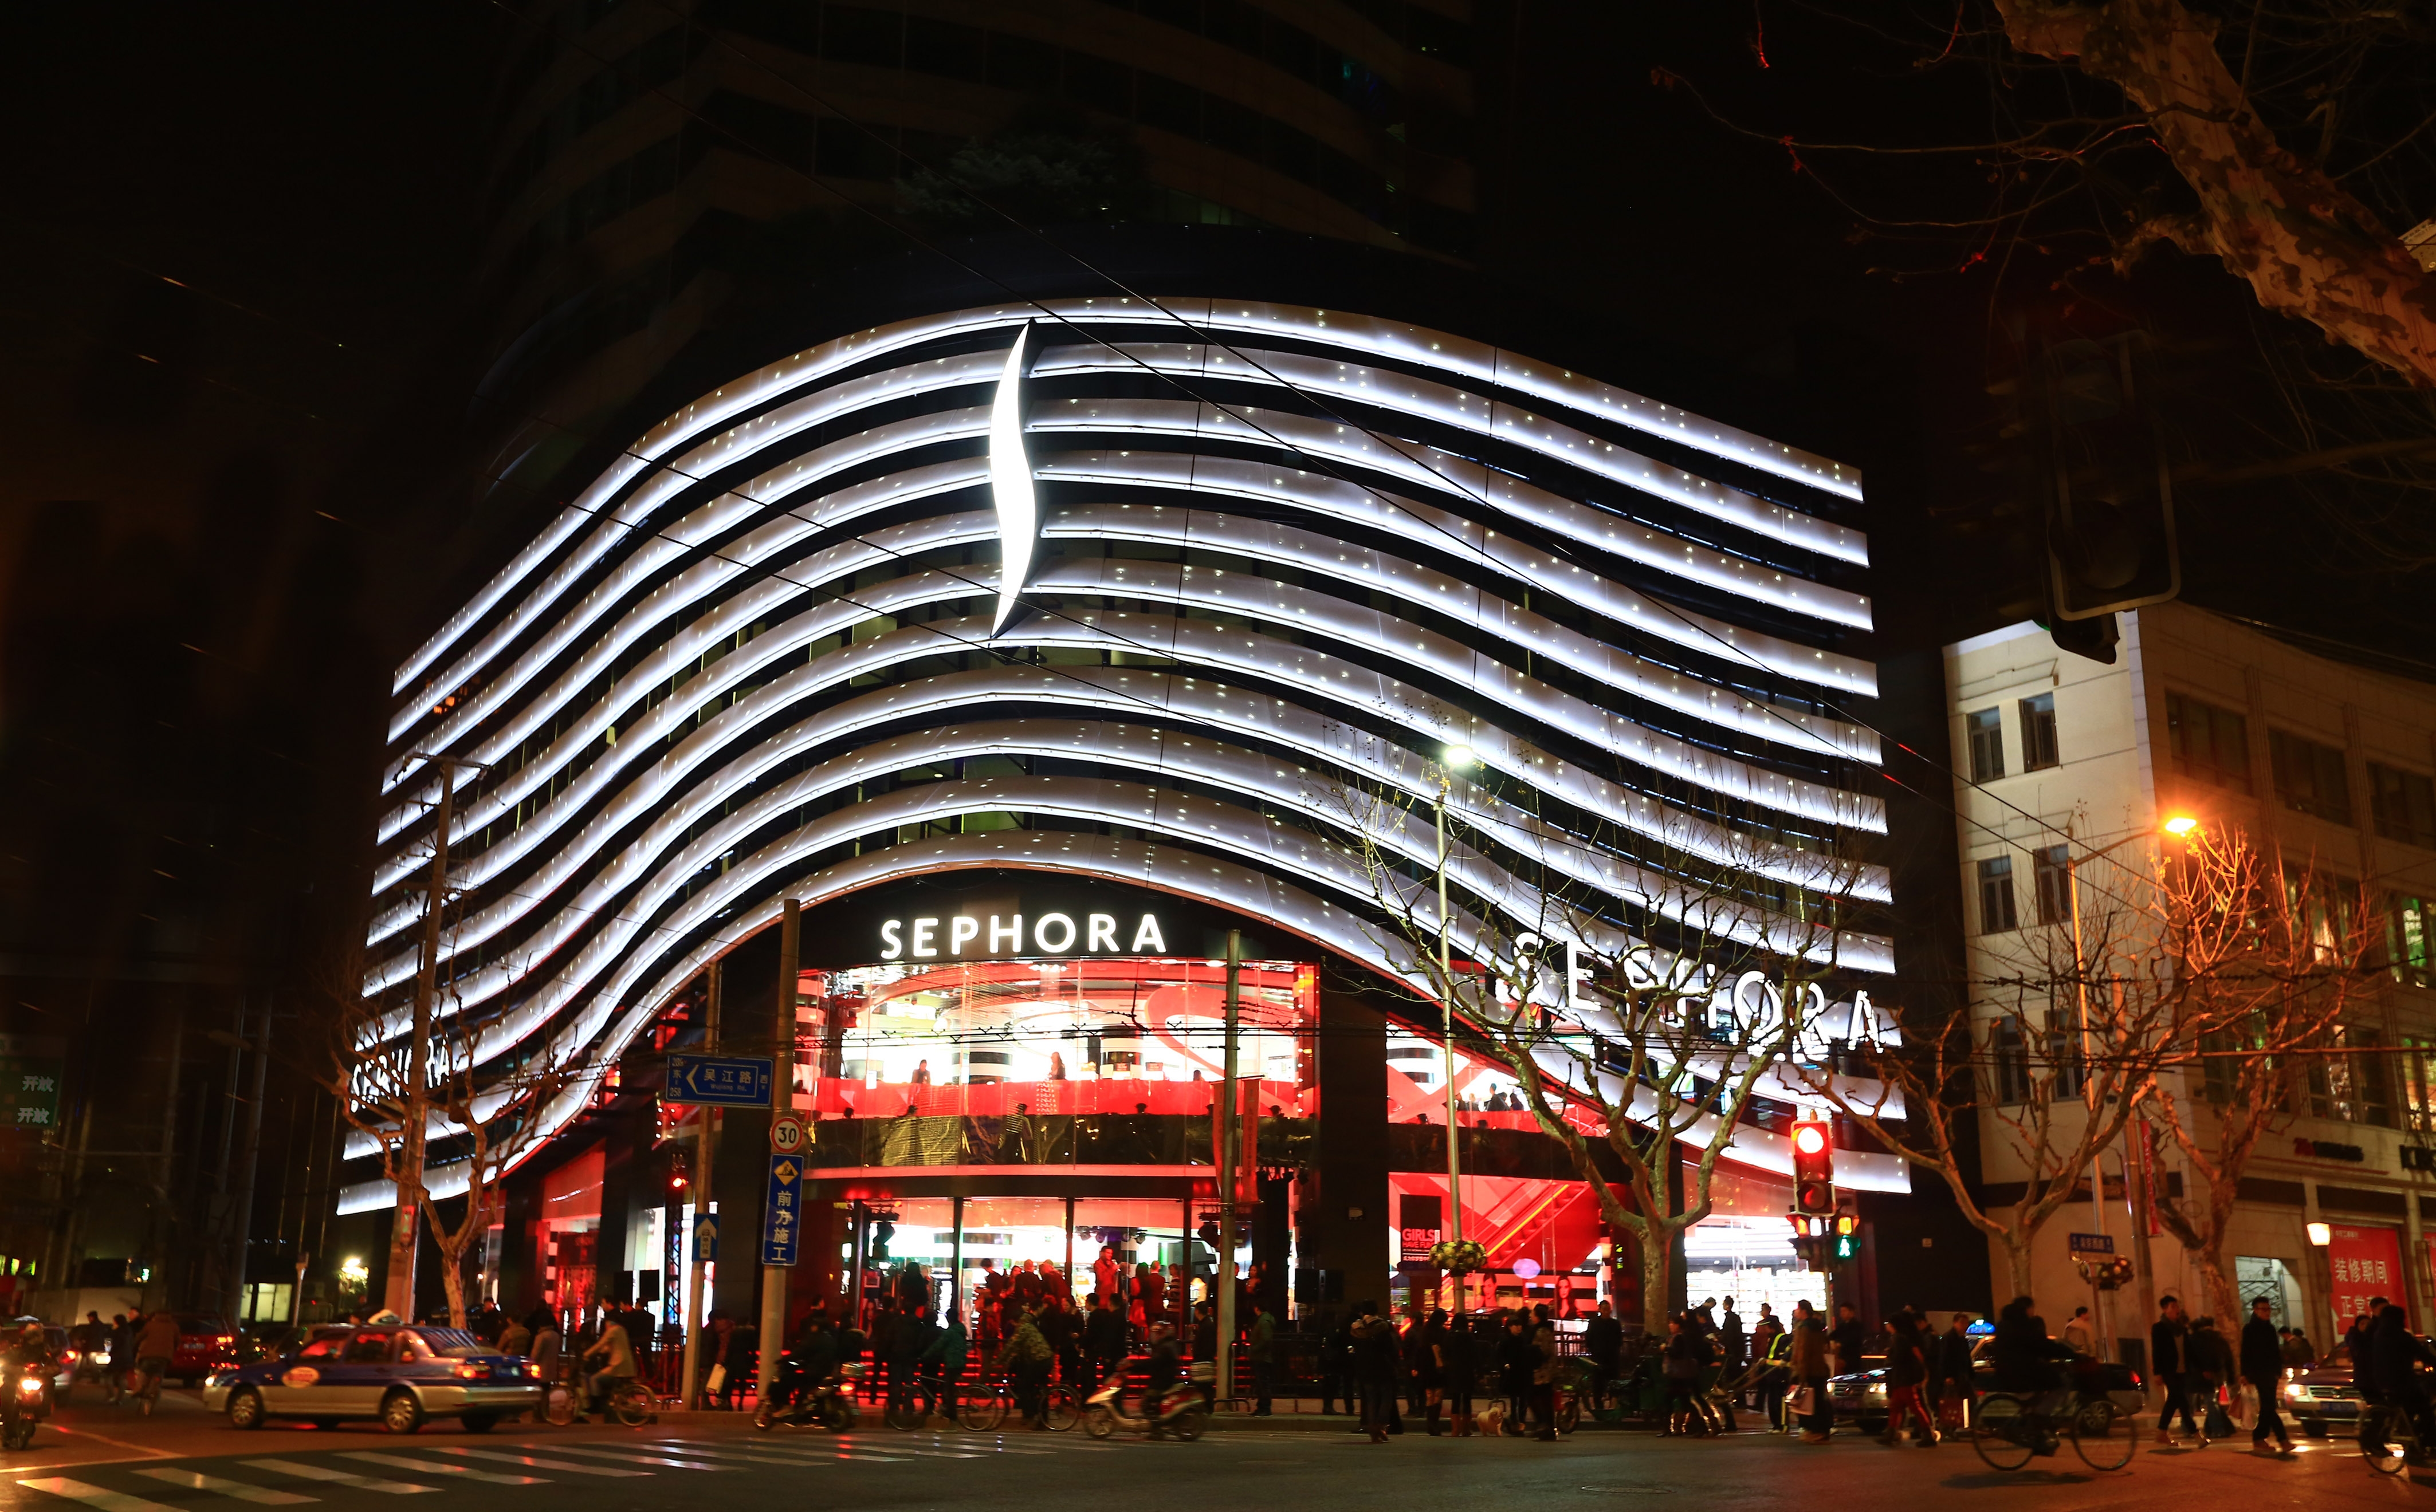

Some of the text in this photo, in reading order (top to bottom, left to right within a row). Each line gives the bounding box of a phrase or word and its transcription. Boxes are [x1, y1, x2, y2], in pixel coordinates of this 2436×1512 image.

[881, 912, 1167, 959] SEPHORA
[1496, 932, 1884, 1055] SEPHORA
[704, 1068, 752, 1084] 吴江路
[777, 1127, 797, 1144] 30
[771, 1190, 793, 1261] 前方施工
[1402, 1228, 1435, 1242] GIRLS
[2334, 1257, 2388, 1284] 装修期间
